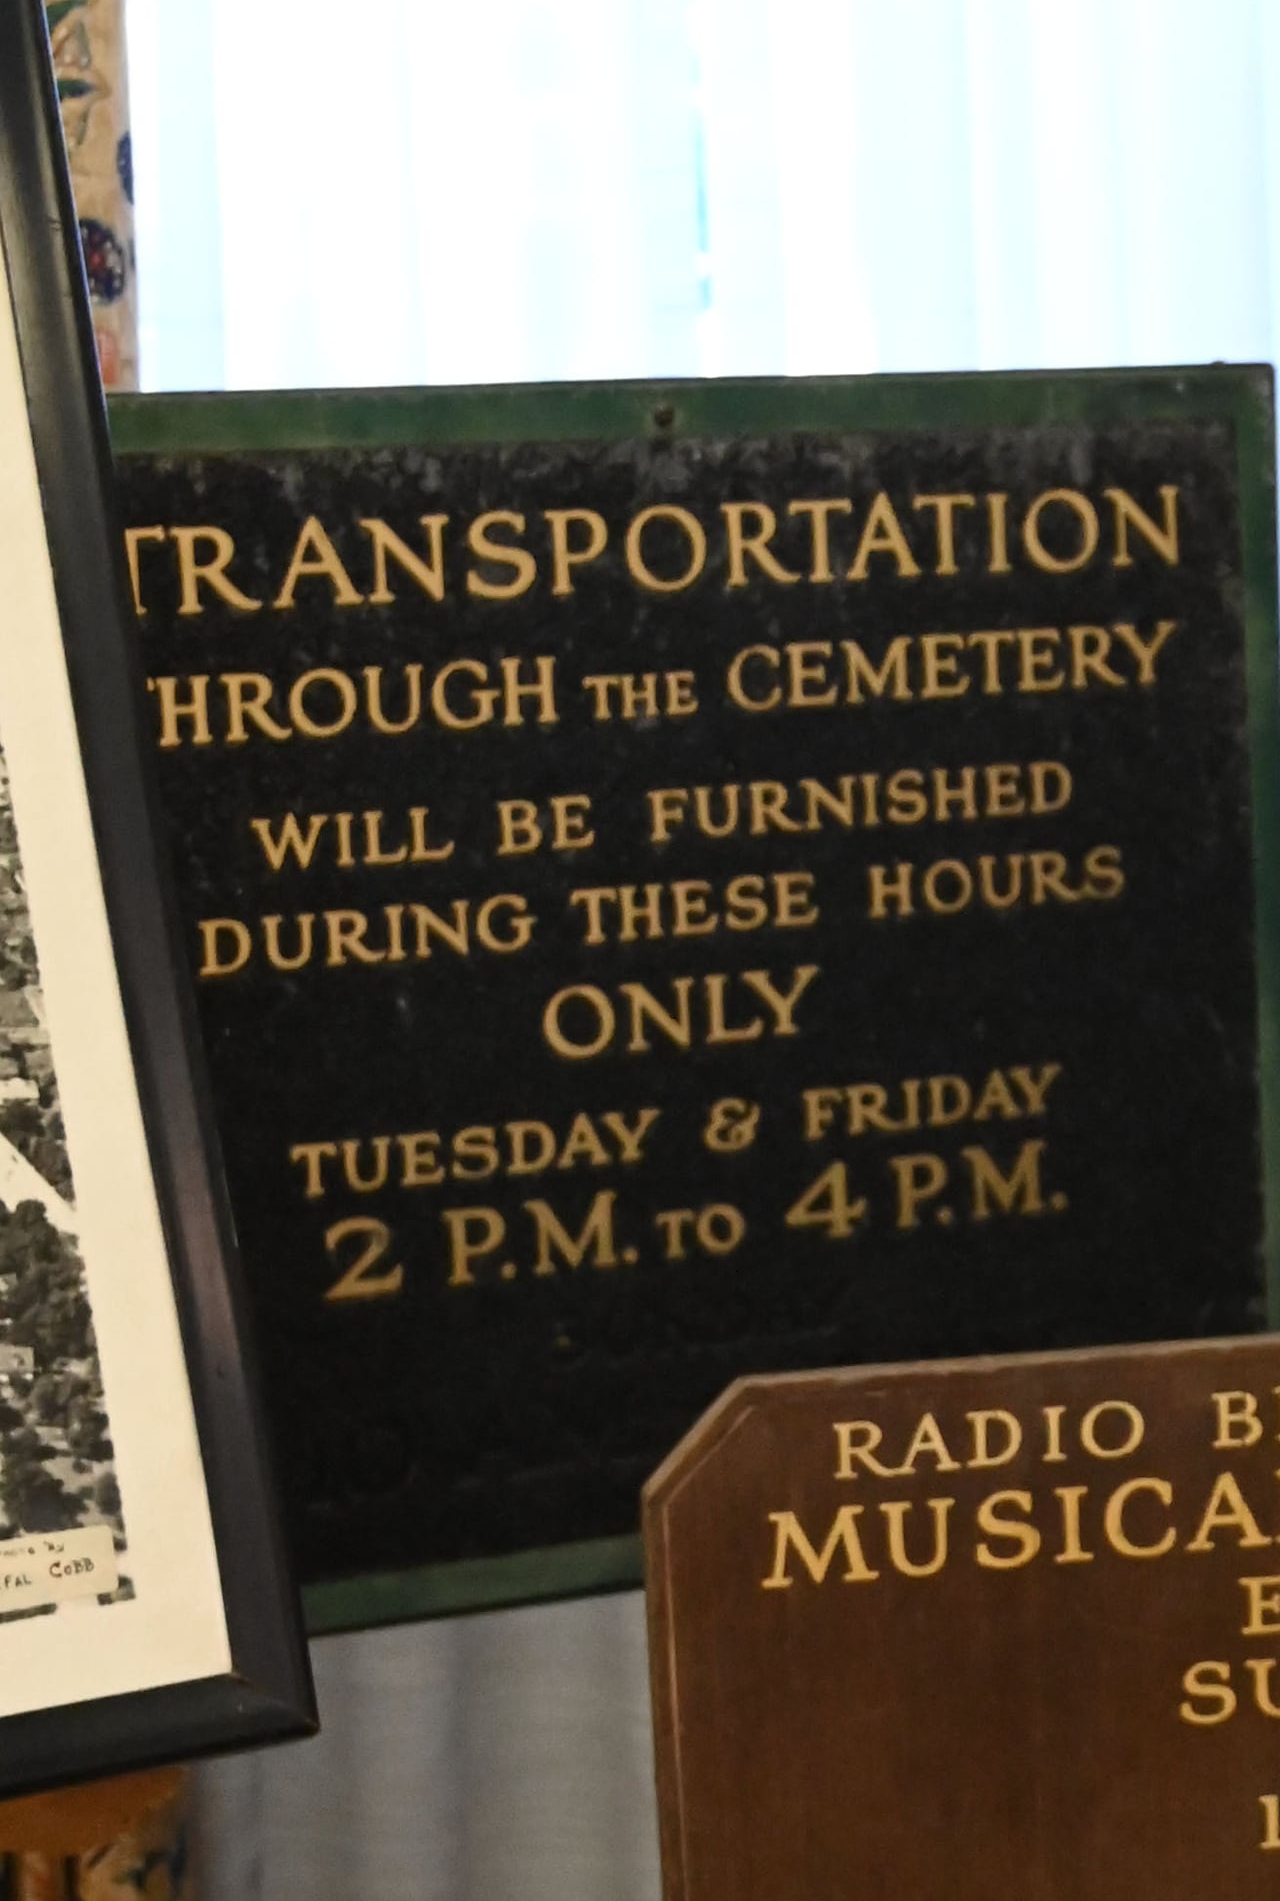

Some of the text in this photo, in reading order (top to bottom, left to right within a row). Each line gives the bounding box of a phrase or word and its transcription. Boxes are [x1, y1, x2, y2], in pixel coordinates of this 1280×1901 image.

[146, 620, 1176, 747] HROUGH THE CEMETERY
[251, 760, 1073, 871] WILL BE FURNISHED
[199, 845, 1126, 977] DURING THESE HOURS
[541, 964, 822, 1059] ONLY
[289, 1063, 1063, 1200] TUESDAY & FRIDAY
[325, 1215, 404, 1302] 2
[656, 1203, 745, 1260] TO
[786, 1161, 868, 1242] 4
[892, 1138, 1070, 1231] P.M.
[832, 1399, 1146, 1480] RADIO
